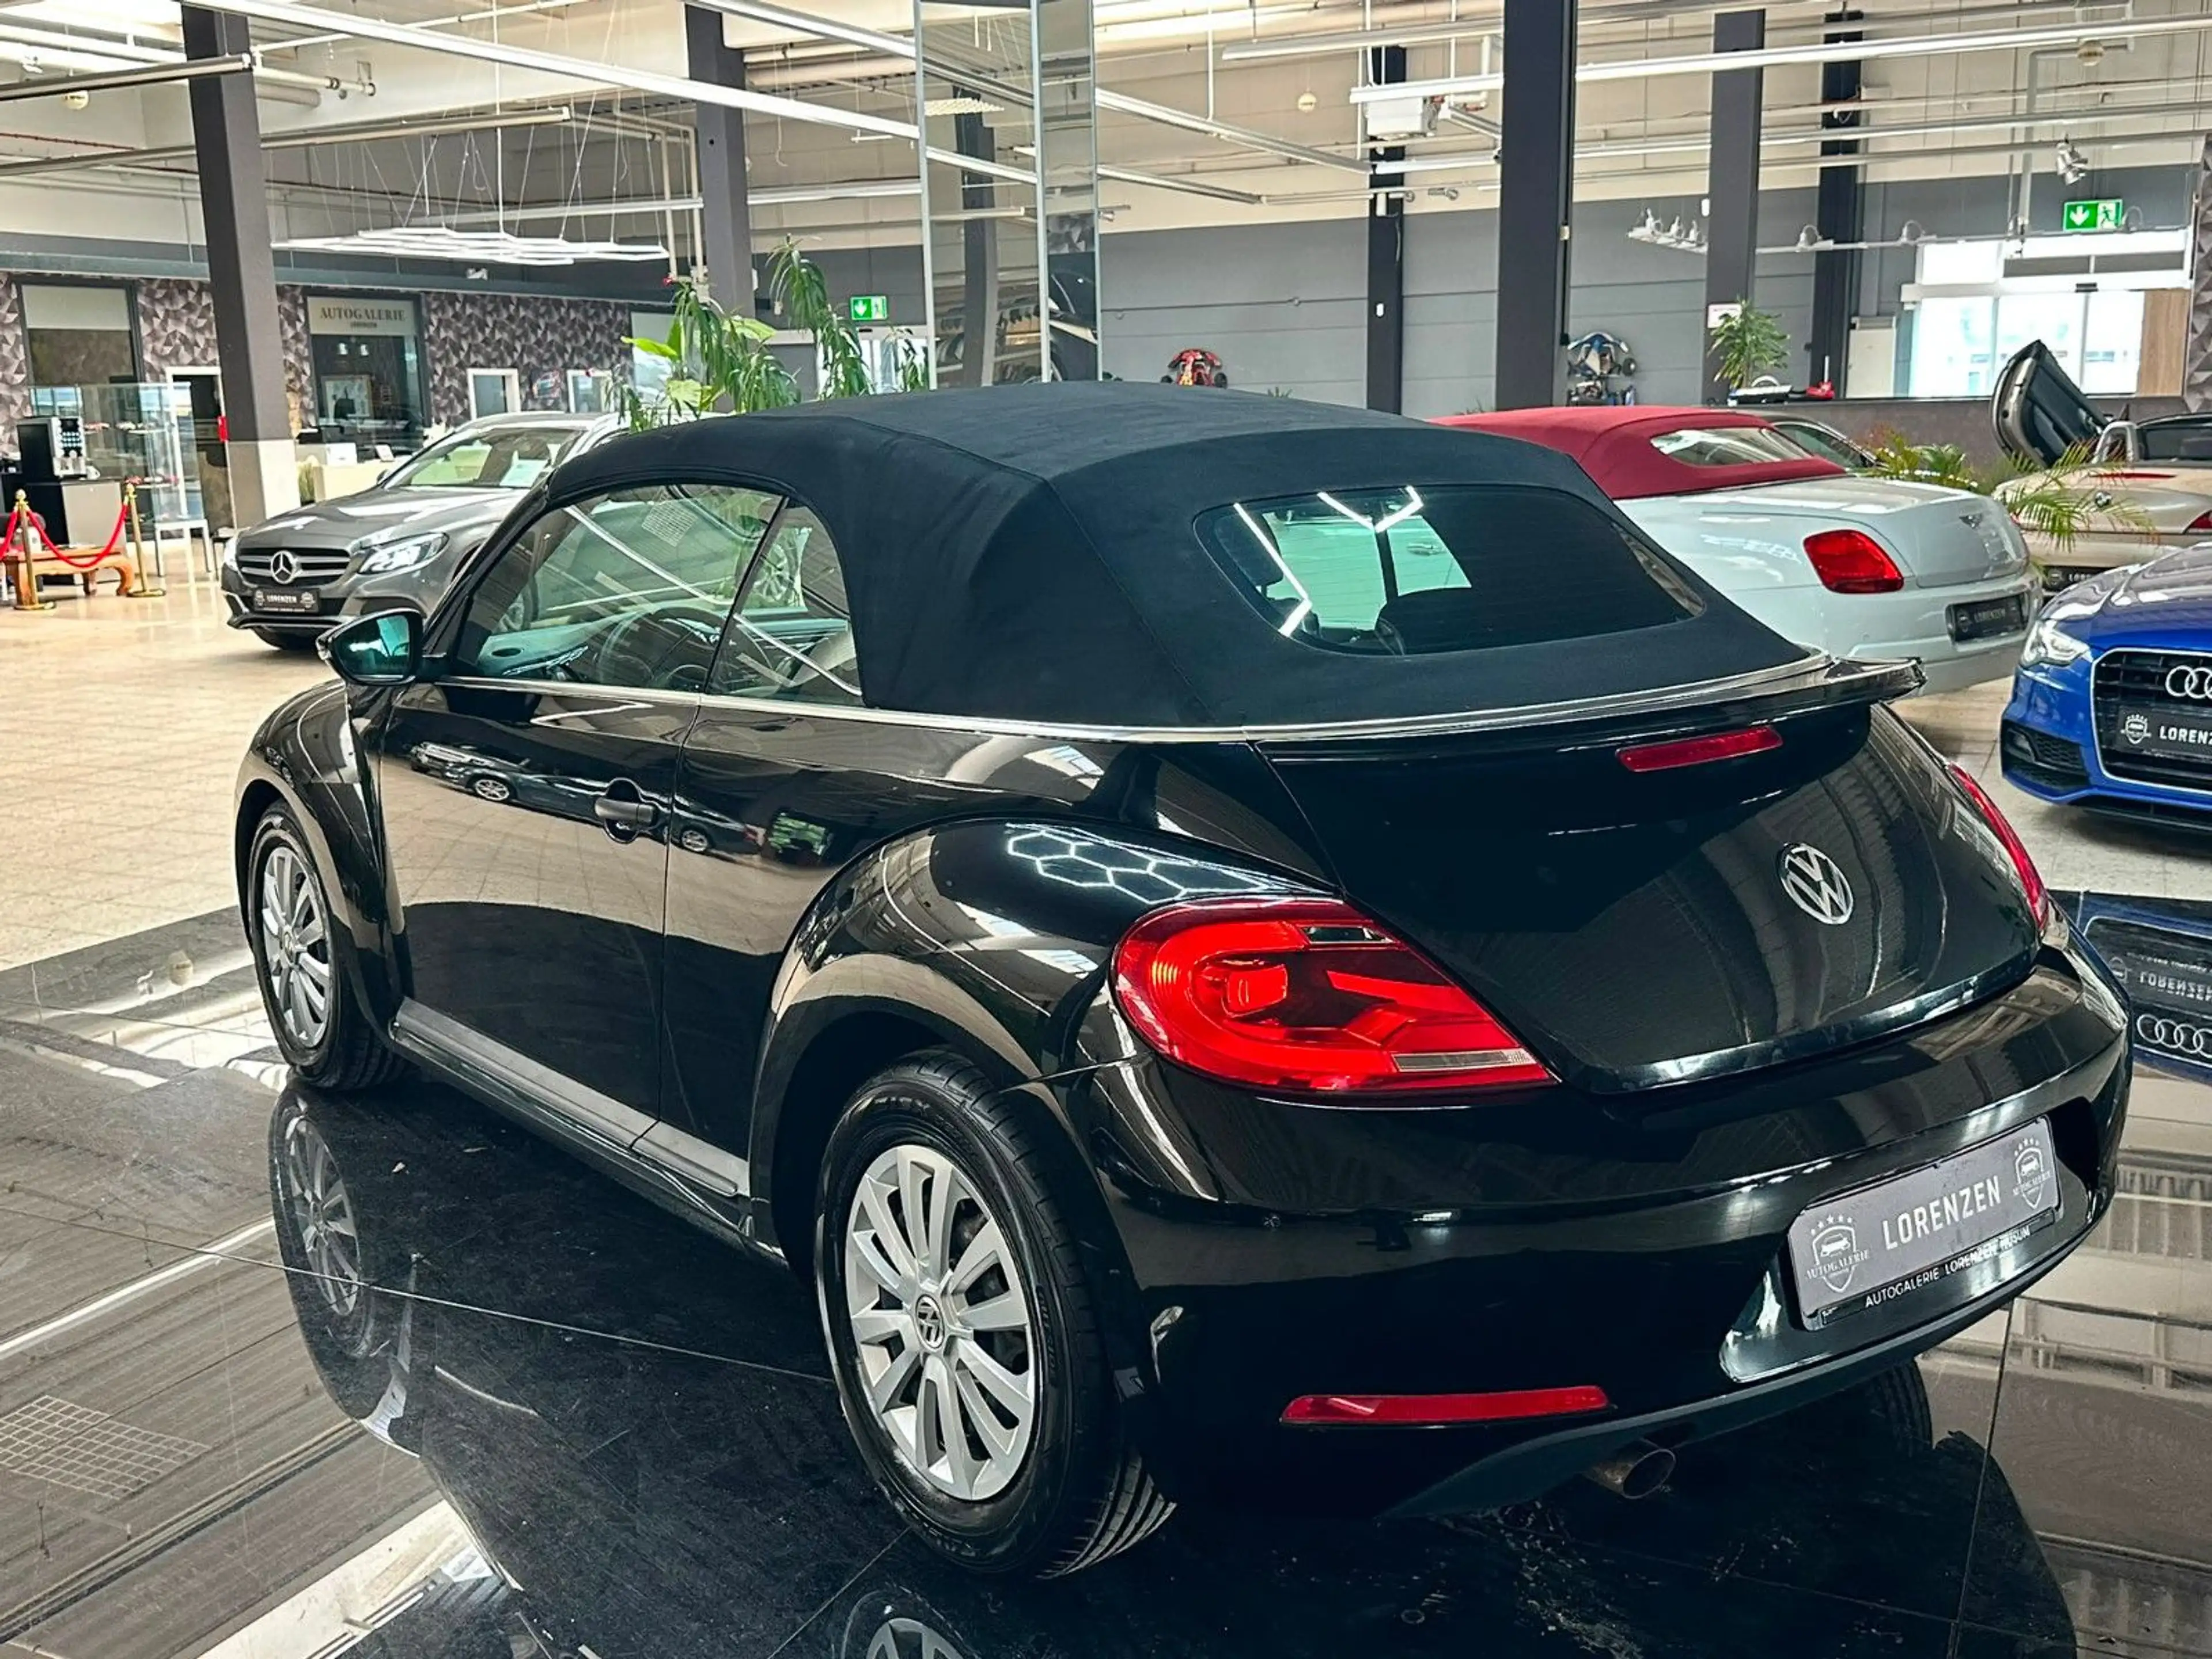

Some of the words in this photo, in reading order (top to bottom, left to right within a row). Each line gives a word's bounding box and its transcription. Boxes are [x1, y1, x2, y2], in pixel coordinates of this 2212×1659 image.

[320, 307, 406, 321] AUTOGALERIE
[1883, 1176, 2001, 1250] LORENZEN
[1865, 1267, 1940, 1308] AUTOGALERIE
